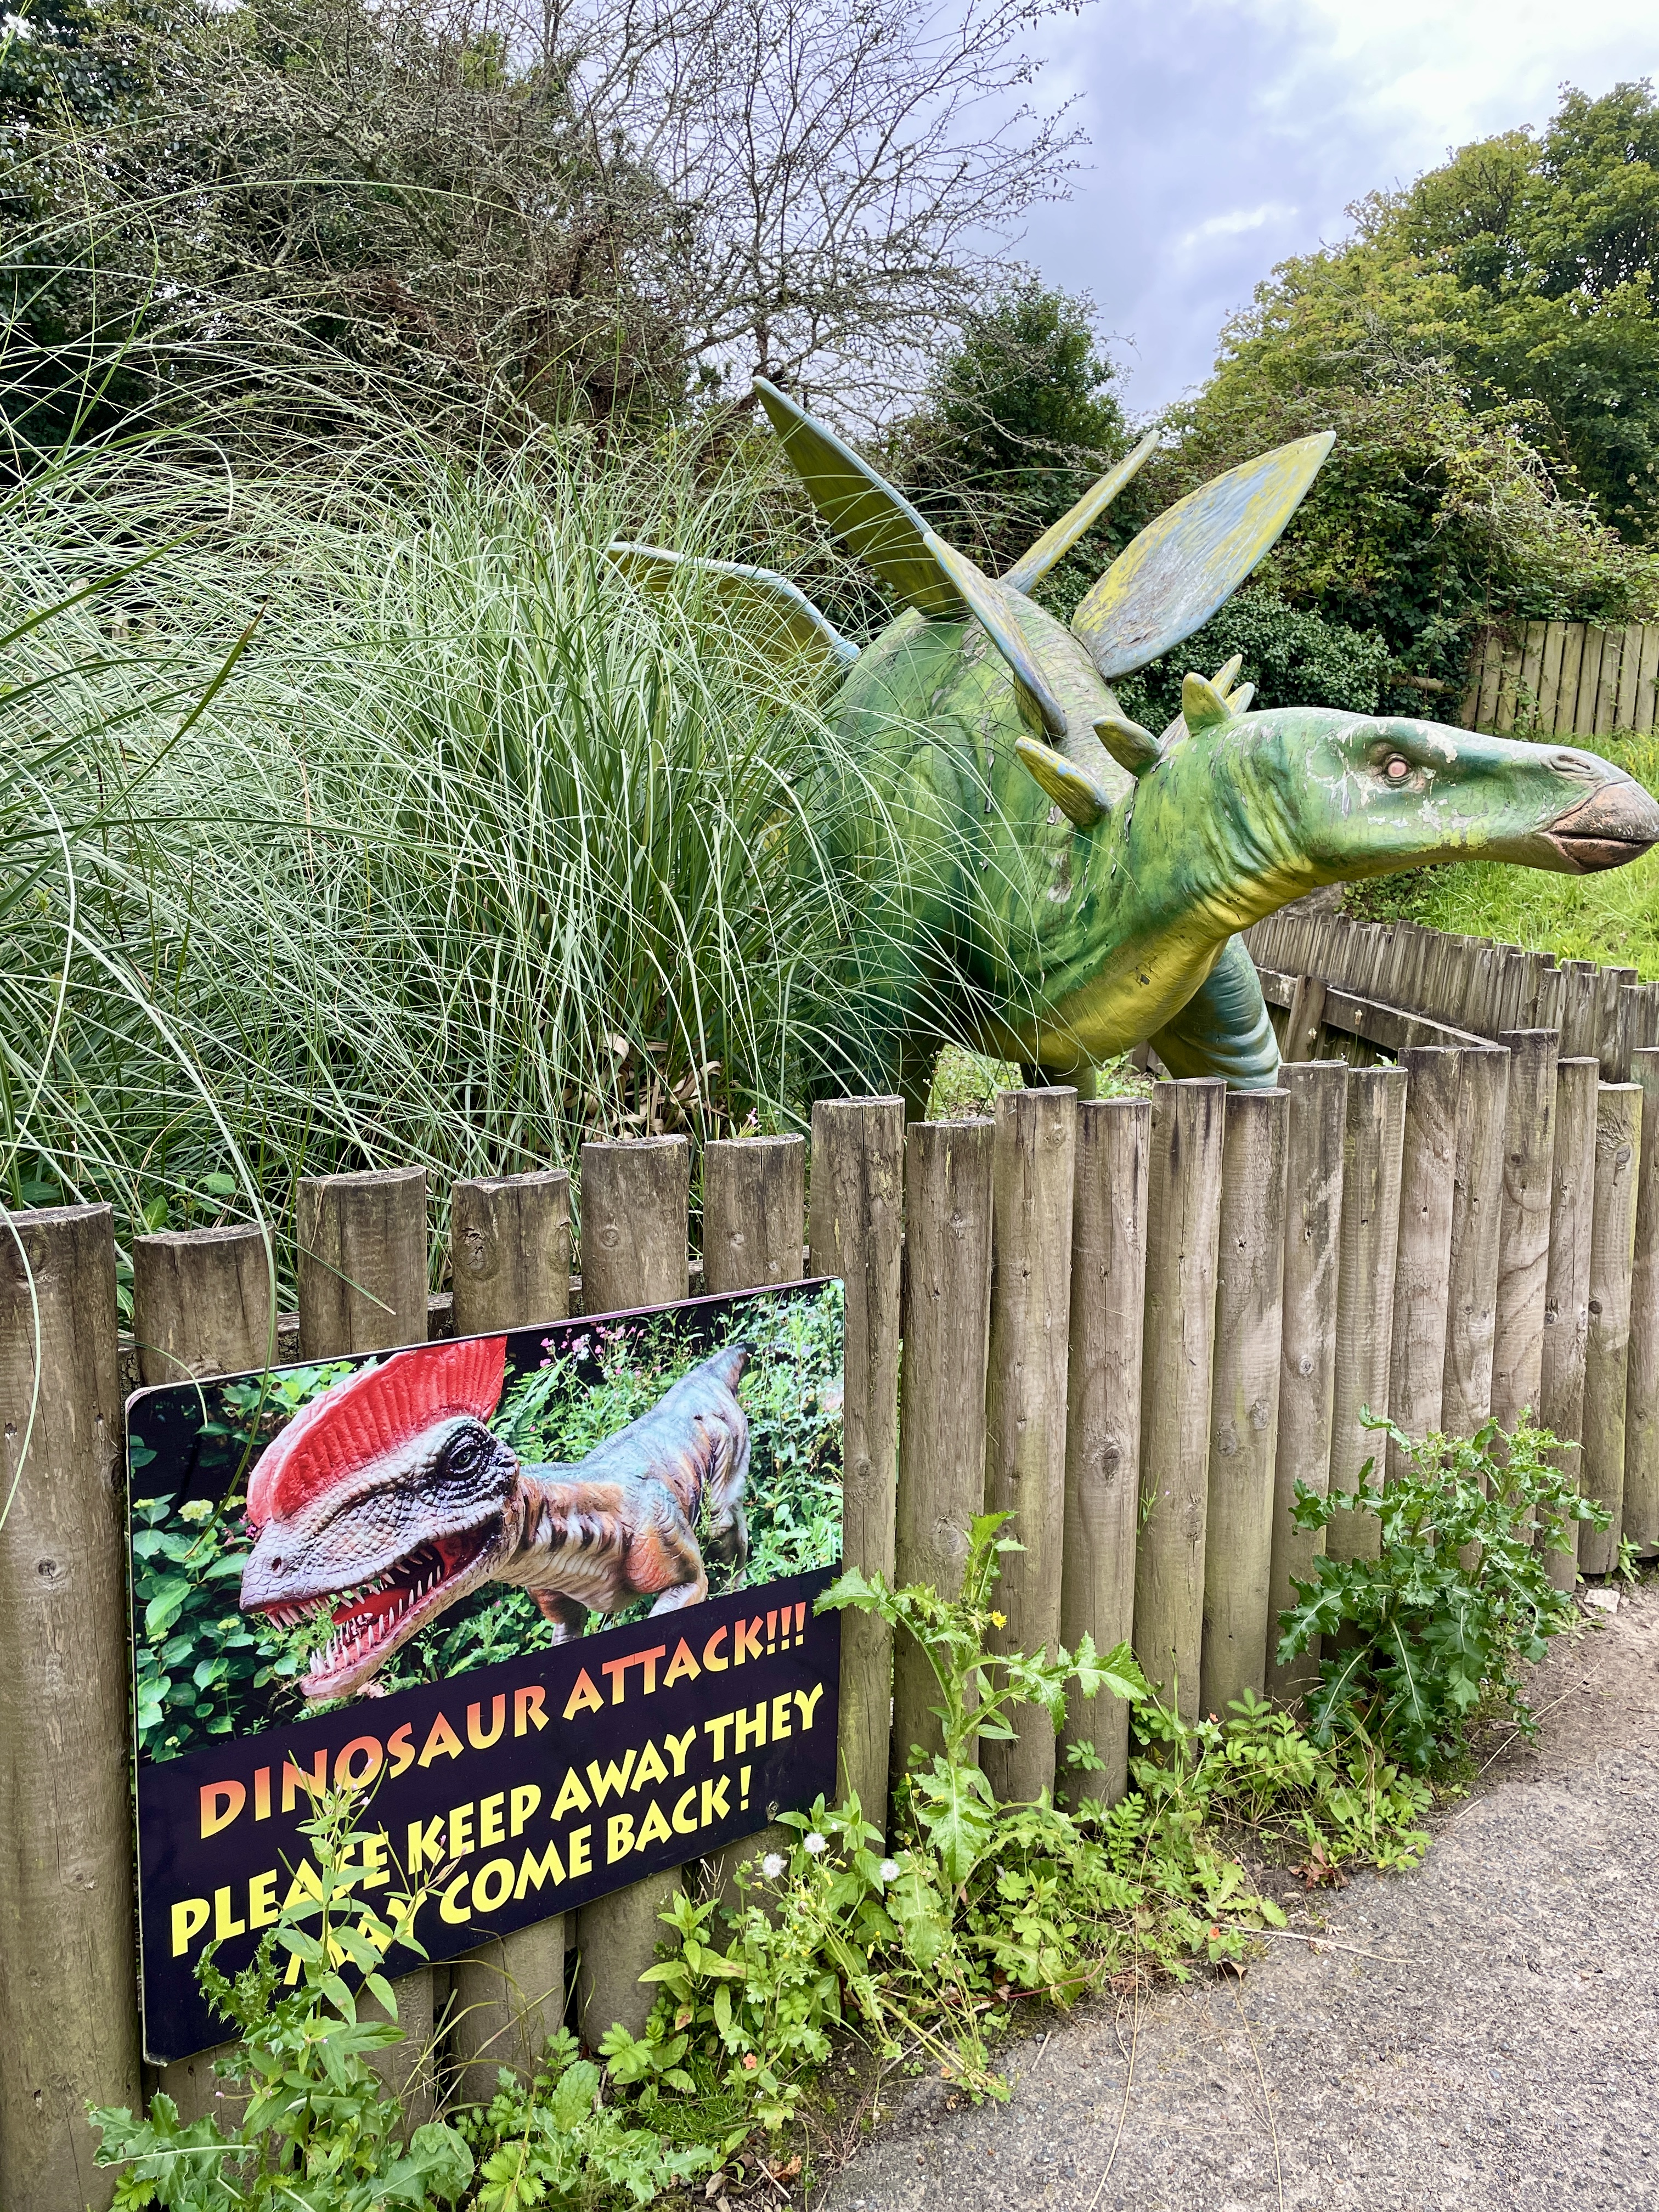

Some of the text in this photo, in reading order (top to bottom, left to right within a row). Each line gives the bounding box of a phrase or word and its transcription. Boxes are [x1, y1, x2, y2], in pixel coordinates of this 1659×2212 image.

[200, 1602, 807, 1839] DINOSAUR ATTACK!!!
[407, 1784, 541, 1875] KEEP
[551, 1725, 697, 1820] AWAY
[703, 1681, 825, 1763] THEY
[439, 1824, 593, 1925] COME
[607, 1774, 731, 1865] BACK
[741, 1765, 752, 1810] !
